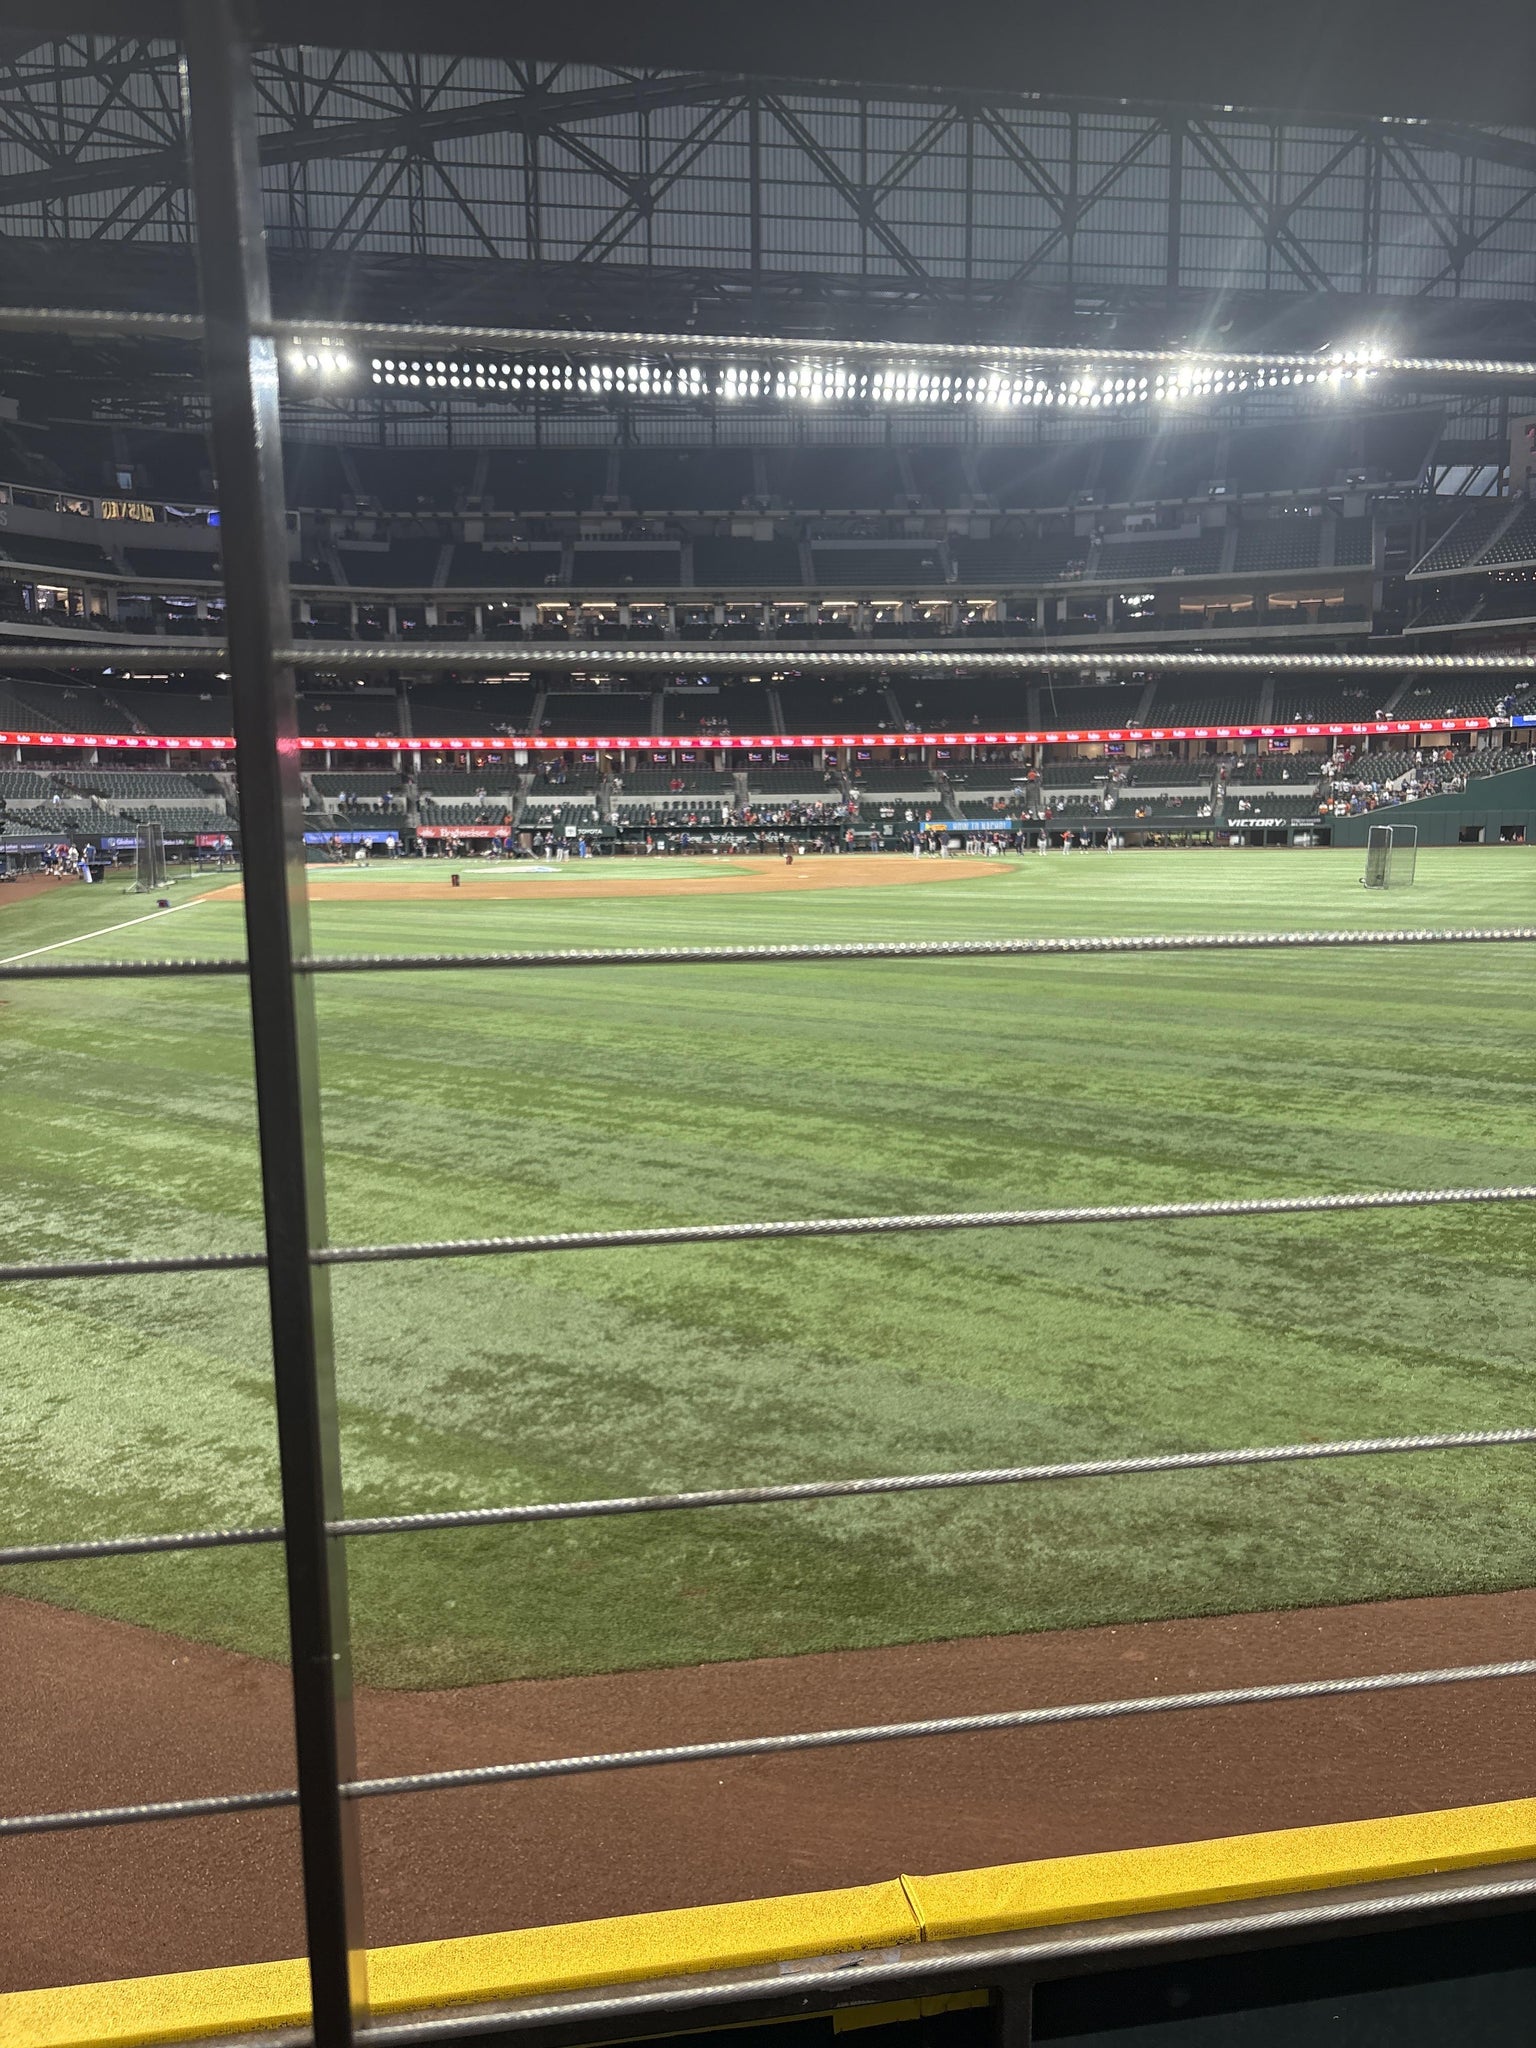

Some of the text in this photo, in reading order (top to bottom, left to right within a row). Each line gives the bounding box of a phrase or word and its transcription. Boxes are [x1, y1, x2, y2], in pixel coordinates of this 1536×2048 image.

[1046, 732, 1058, 740] fubo
[1352, 724, 1367, 732] fubo
[1228, 818, 1282, 827] VICTORY
[439, 828, 490, 838] Budweiser
